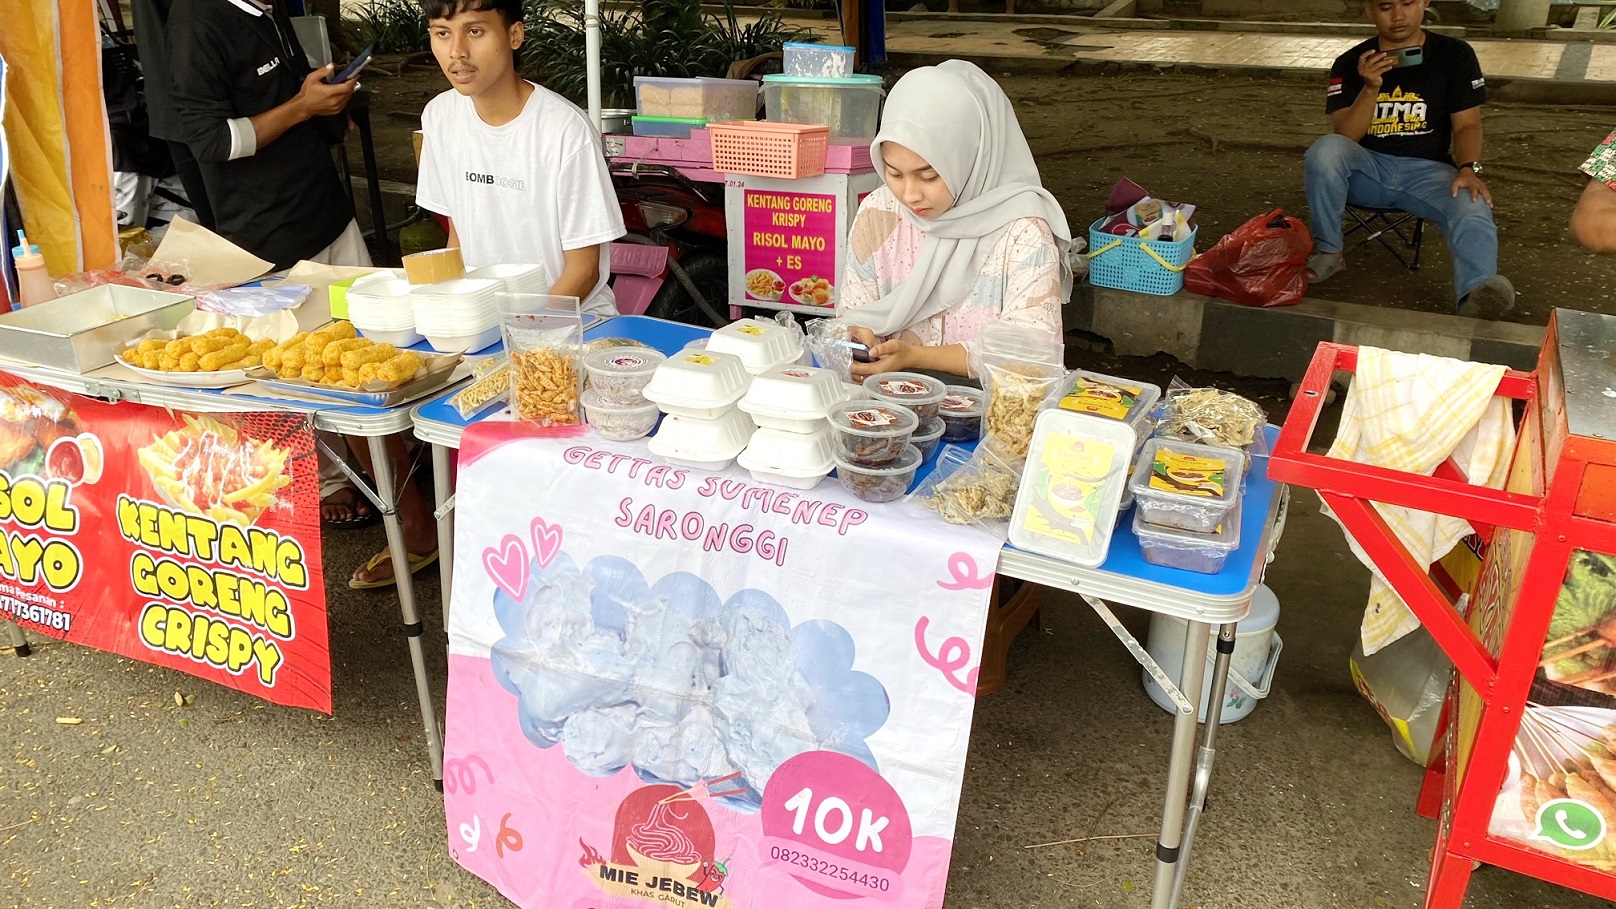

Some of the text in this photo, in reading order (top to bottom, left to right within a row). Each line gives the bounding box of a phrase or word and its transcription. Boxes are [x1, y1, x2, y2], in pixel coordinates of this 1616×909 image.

[256, 57, 280, 76] BELLA
[747, 193, 833, 213] KENTANG GORENG
[772, 212, 806, 228] KRISPY
[753, 231, 826, 251] RISOL MAYO
[775, 254, 803, 270] + ES
[563, 445, 869, 536] GETTAS SUMENEP
[117, 496, 307, 588] KENTANG
[614, 497, 789, 566] SARONGGI
[0, 594, 71, 632] 717361781
[132, 553, 292, 638] GORENG
[141, 604, 281, 684] CRISPY
[784, 787, 890, 853] 10K
[599, 864, 719, 908] MIE JEBEW
[770, 846, 890, 892] 082332254430
[630, 888, 686, 909] KHAS GARUT
